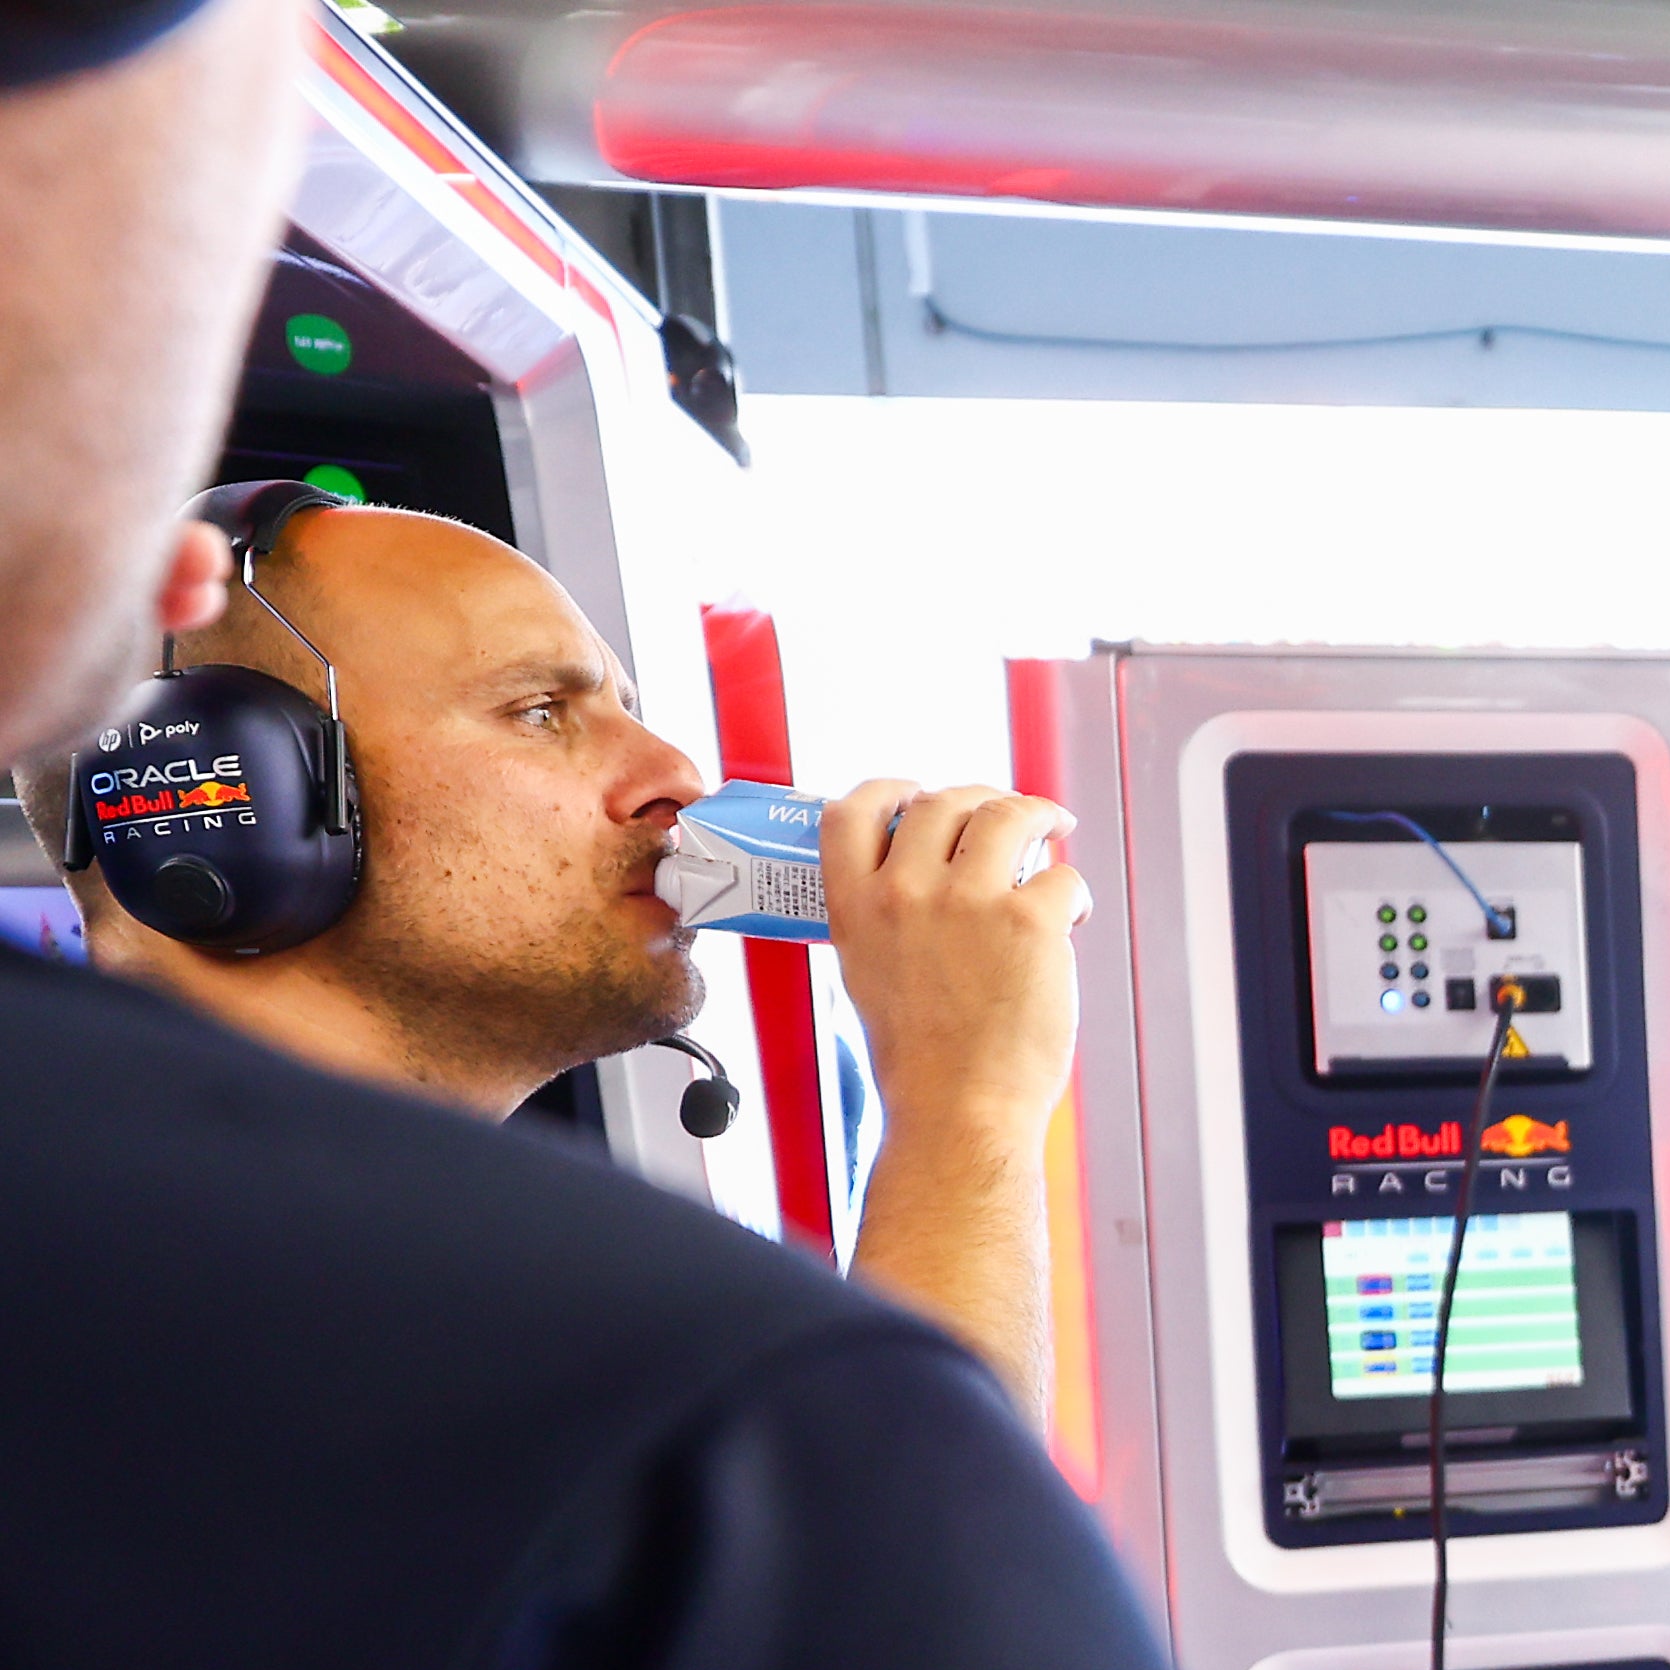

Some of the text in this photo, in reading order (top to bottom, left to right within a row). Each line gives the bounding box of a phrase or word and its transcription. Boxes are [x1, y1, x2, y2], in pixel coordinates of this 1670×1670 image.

[99, 721, 199, 751] hp poly
[91, 755, 242, 795] ORACLE
[95, 790, 174, 820] Red Bull
[103, 812, 256, 844] RACING
[1329, 1121, 1462, 1160] Red Bull
[1332, 1165, 1571, 1196] RACNG
